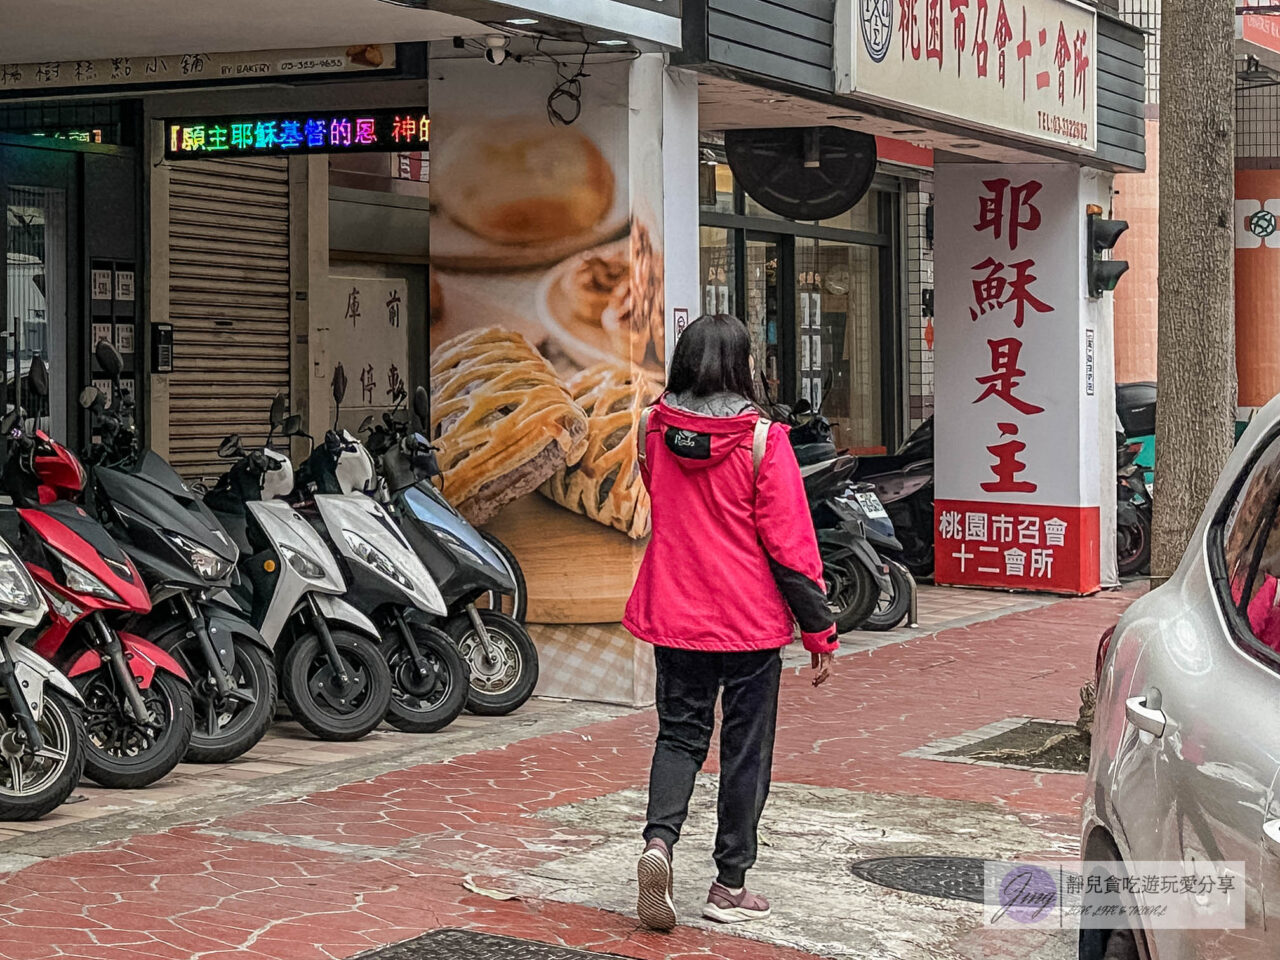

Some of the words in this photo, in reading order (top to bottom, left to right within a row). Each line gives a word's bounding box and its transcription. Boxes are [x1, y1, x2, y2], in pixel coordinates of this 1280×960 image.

[969, 177, 1055, 494] 耶穌是主
[939, 510, 1068, 547] 桃園市召會
[952, 543, 1054, 579] 十二會所
